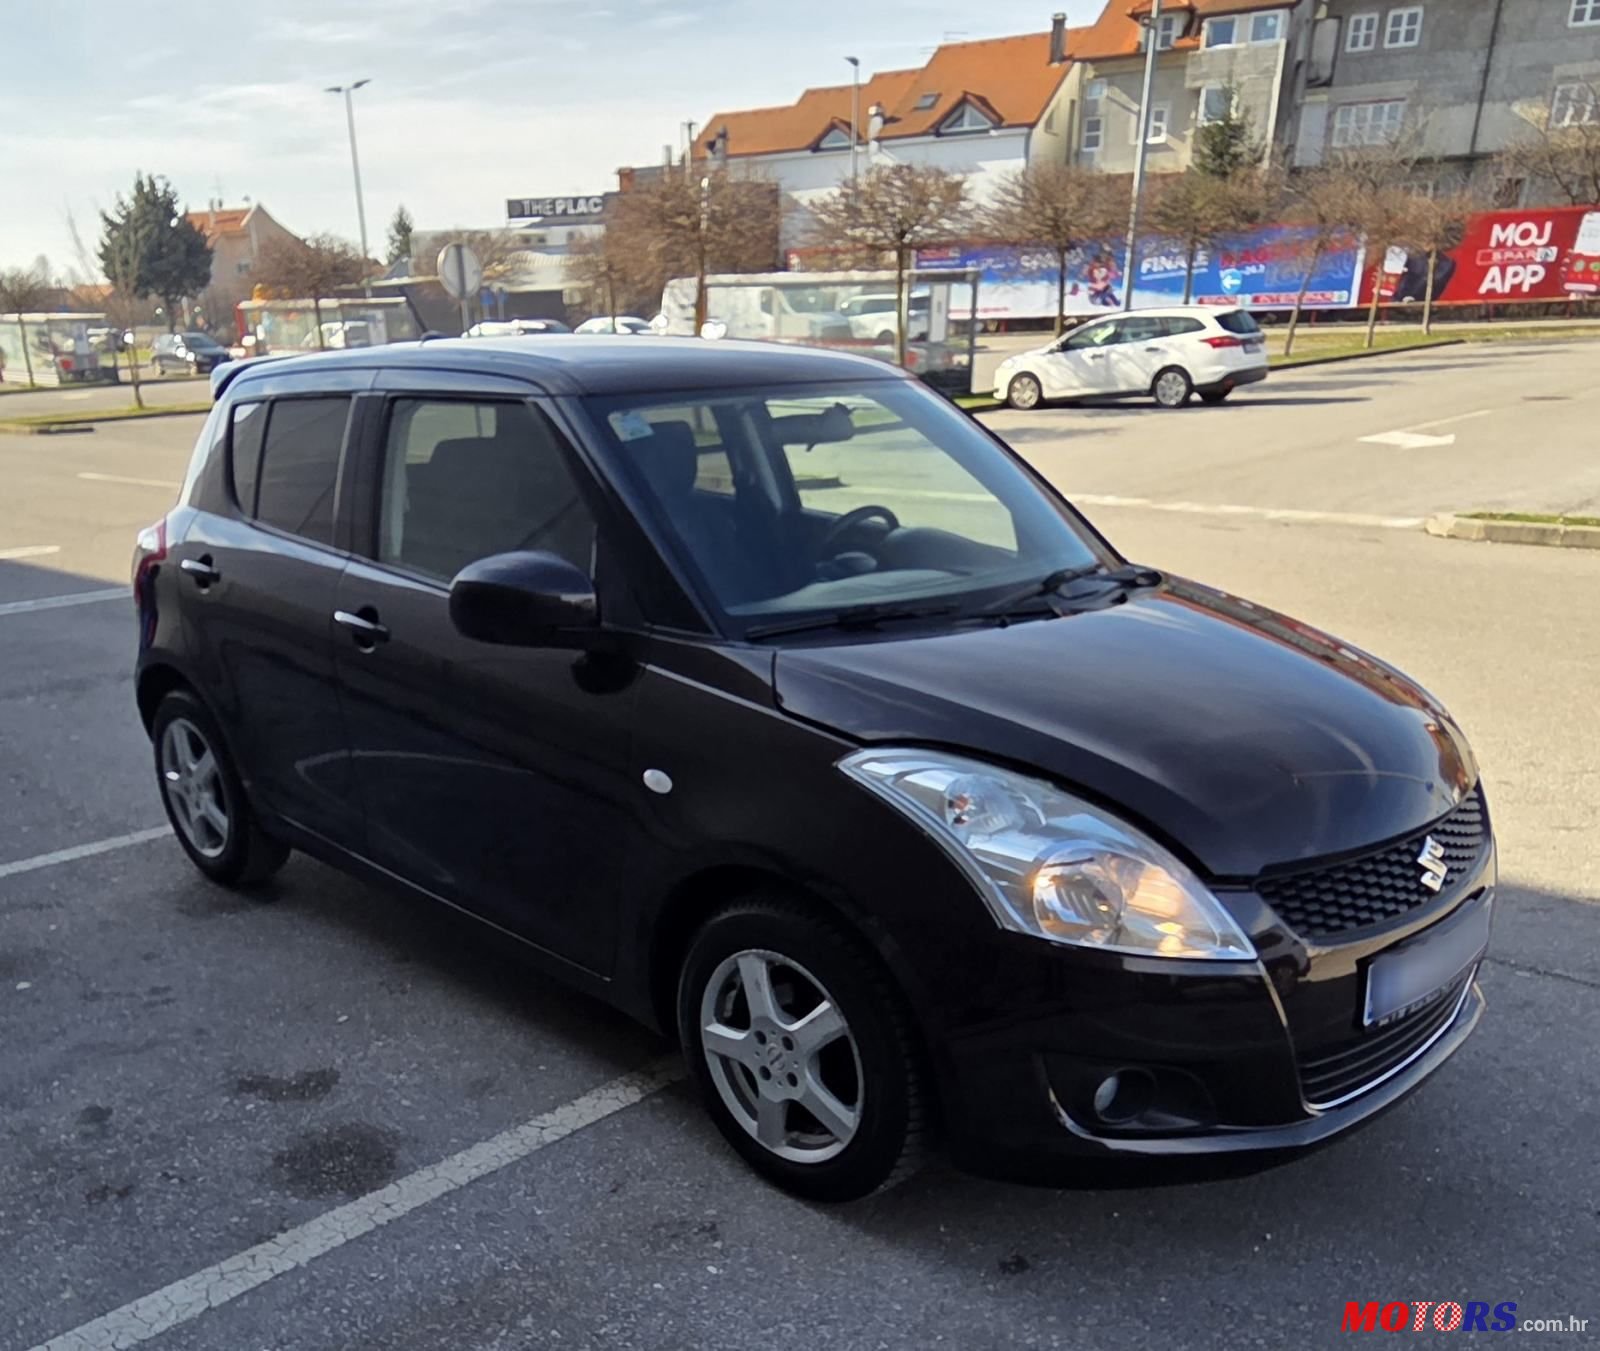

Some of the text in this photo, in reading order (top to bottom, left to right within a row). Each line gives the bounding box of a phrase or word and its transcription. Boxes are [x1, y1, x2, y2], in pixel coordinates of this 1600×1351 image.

[522, 197, 603, 215] THE PLAC
[1489, 221, 1552, 248] MOJ
[1141, 250, 1209, 273] FINAE
[1478, 264, 1545, 294] APP
